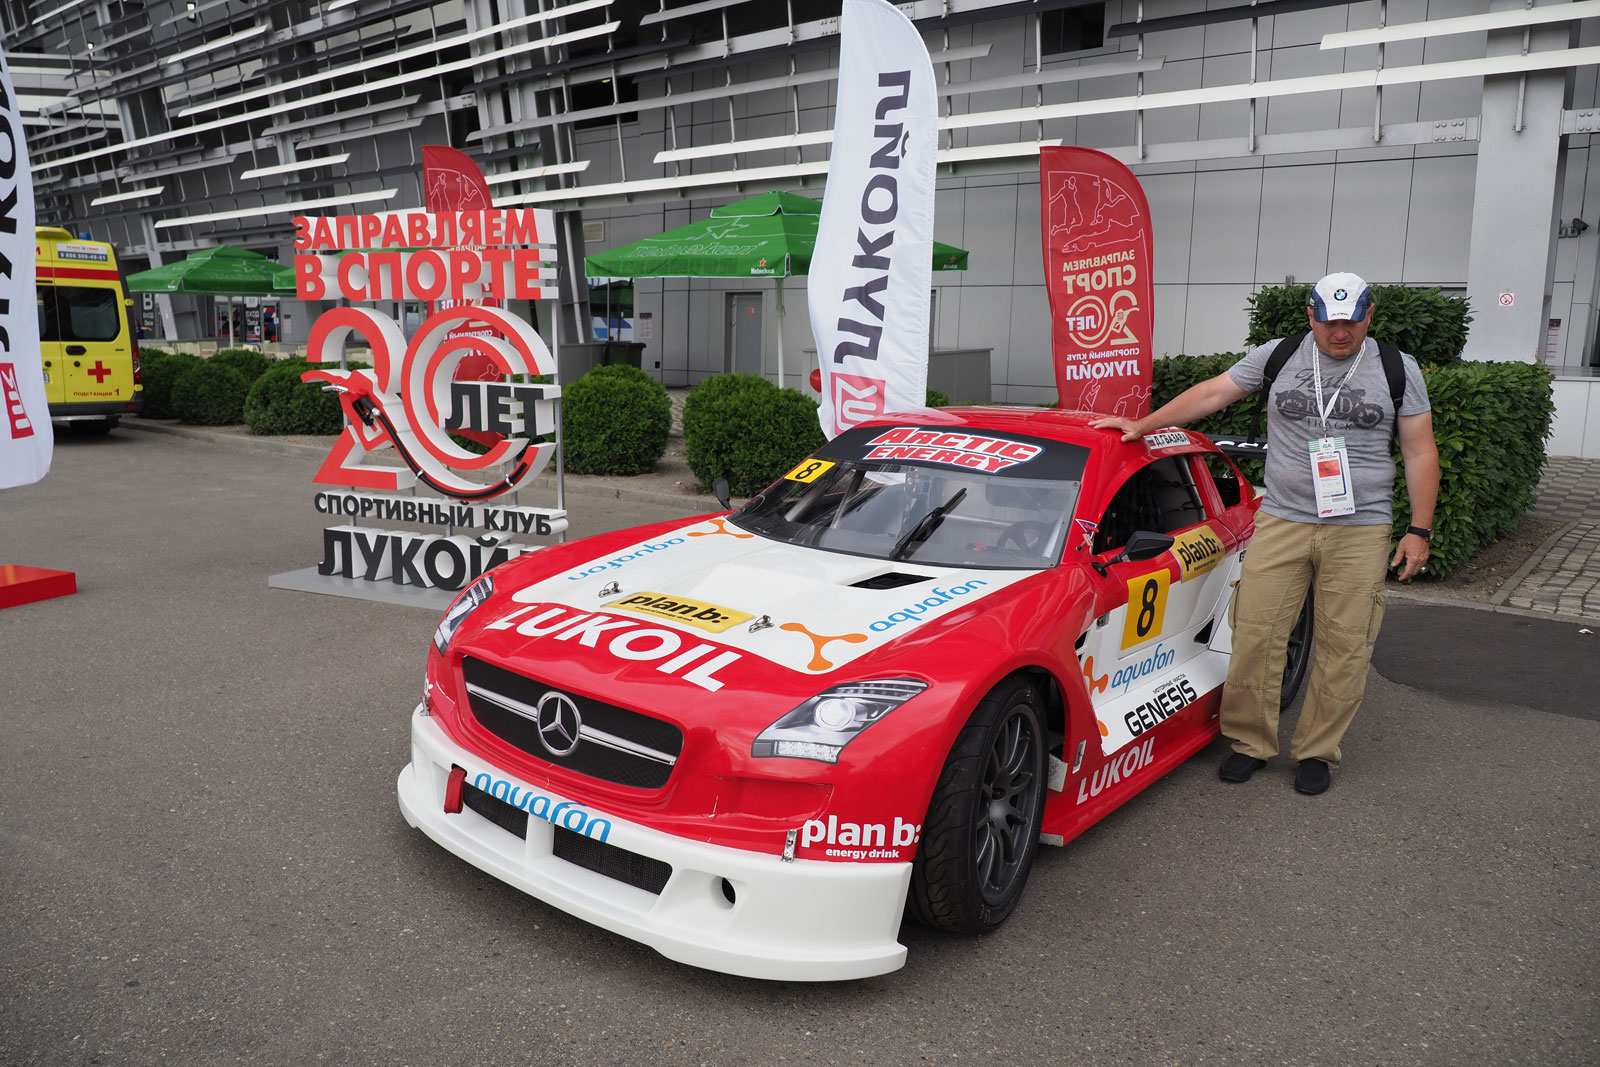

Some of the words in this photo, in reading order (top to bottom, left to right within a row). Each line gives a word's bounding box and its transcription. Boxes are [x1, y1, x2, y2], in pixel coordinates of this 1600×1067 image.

[292, 208, 539, 251] ЗАПРАВЛЯЕМ
[295, 253, 326, 301] В
[337, 249, 541, 301] СПОРТЕ
[114, 388, 120, 396] 1
[445, 383, 545, 435] ЛЕТ
[794, 462, 823, 480] 8
[864, 445, 1020, 474] ENERGY
[314, 491, 475, 529] СПОРТИВНЫЙ
[484, 509, 552, 536] КЛУБ
[318, 528, 530, 590] ЛУКОЙ
[568, 537, 685, 580] aquafon
[1177, 540, 1210, 572] plan
[1199, 534, 1221, 555] b:
[620, 594, 695, 616] plan
[694, 607, 729, 623] b:
[869, 579, 988, 632] aquafon
[1136, 578, 1159, 638] 8
[484, 603, 742, 692] LUKOIL
[1111, 643, 1175, 693] aquafon
[1124, 679, 1198, 737] GENESIS
[1076, 736, 1155, 805] LUKOIL
[474, 772, 612, 843] aquafon
[801, 814, 889, 848] plan
[892, 816, 921, 847] b:
[825, 849, 867, 860] energy
[868, 848, 899, 858] drink
